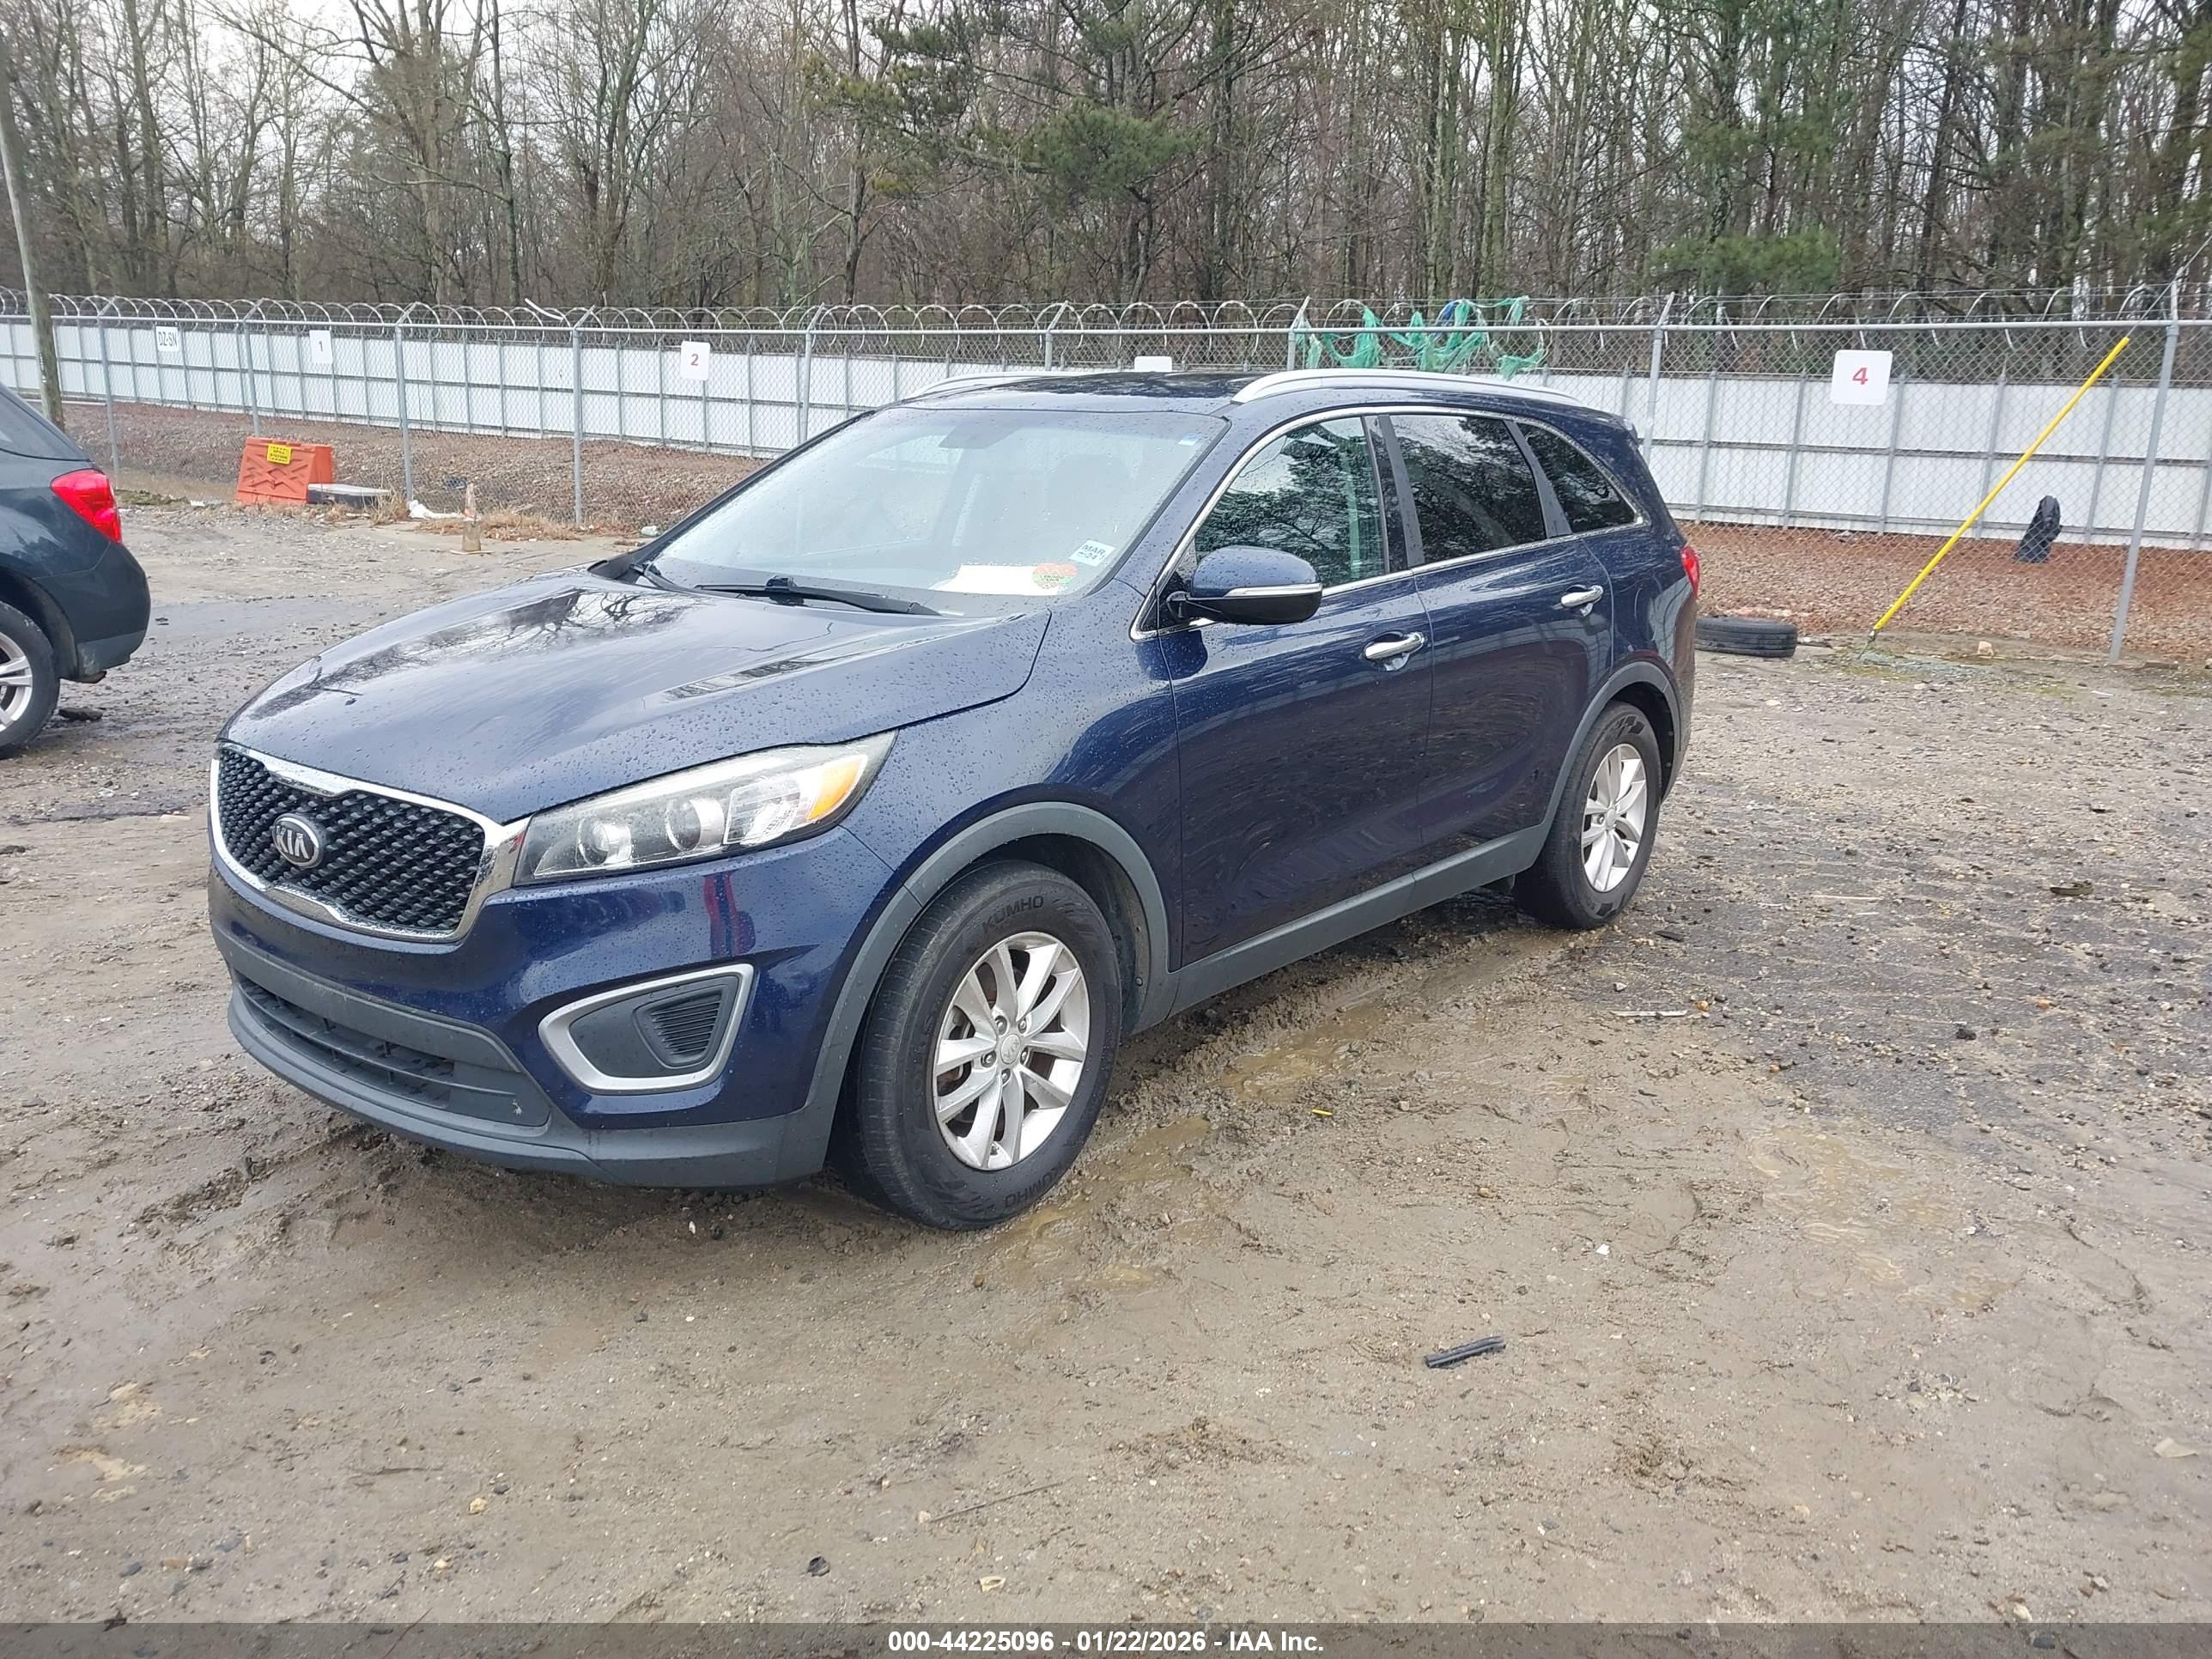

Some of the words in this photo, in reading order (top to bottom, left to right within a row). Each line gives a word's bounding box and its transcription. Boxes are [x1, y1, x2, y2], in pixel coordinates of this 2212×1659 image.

[319, 341, 324, 352] 1
[690, 353, 699, 366] 2
[1852, 367, 1869, 385] 4
[276, 825, 310, 860] KIA
[982, 895, 1044, 930] KUMHO
